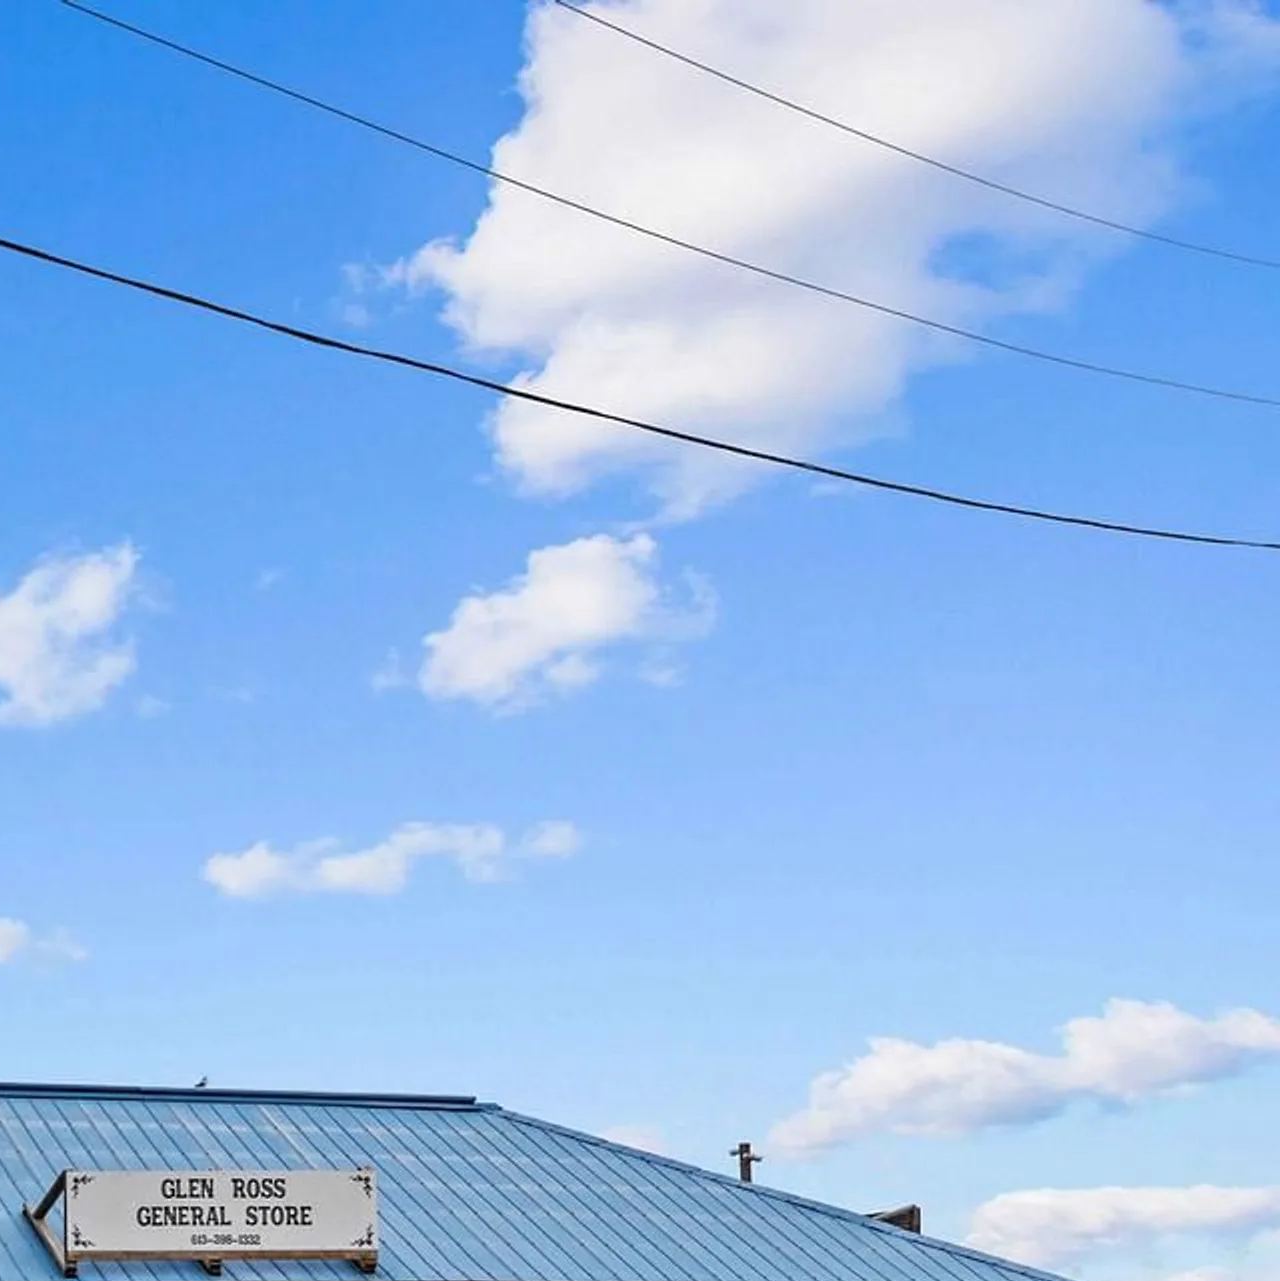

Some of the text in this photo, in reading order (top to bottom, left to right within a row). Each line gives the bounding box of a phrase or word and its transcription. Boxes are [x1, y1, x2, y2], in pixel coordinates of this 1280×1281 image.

[161, 1178, 286, 1198] GLEN ROSS
[136, 1206, 312, 1226] GENERAL STORE
